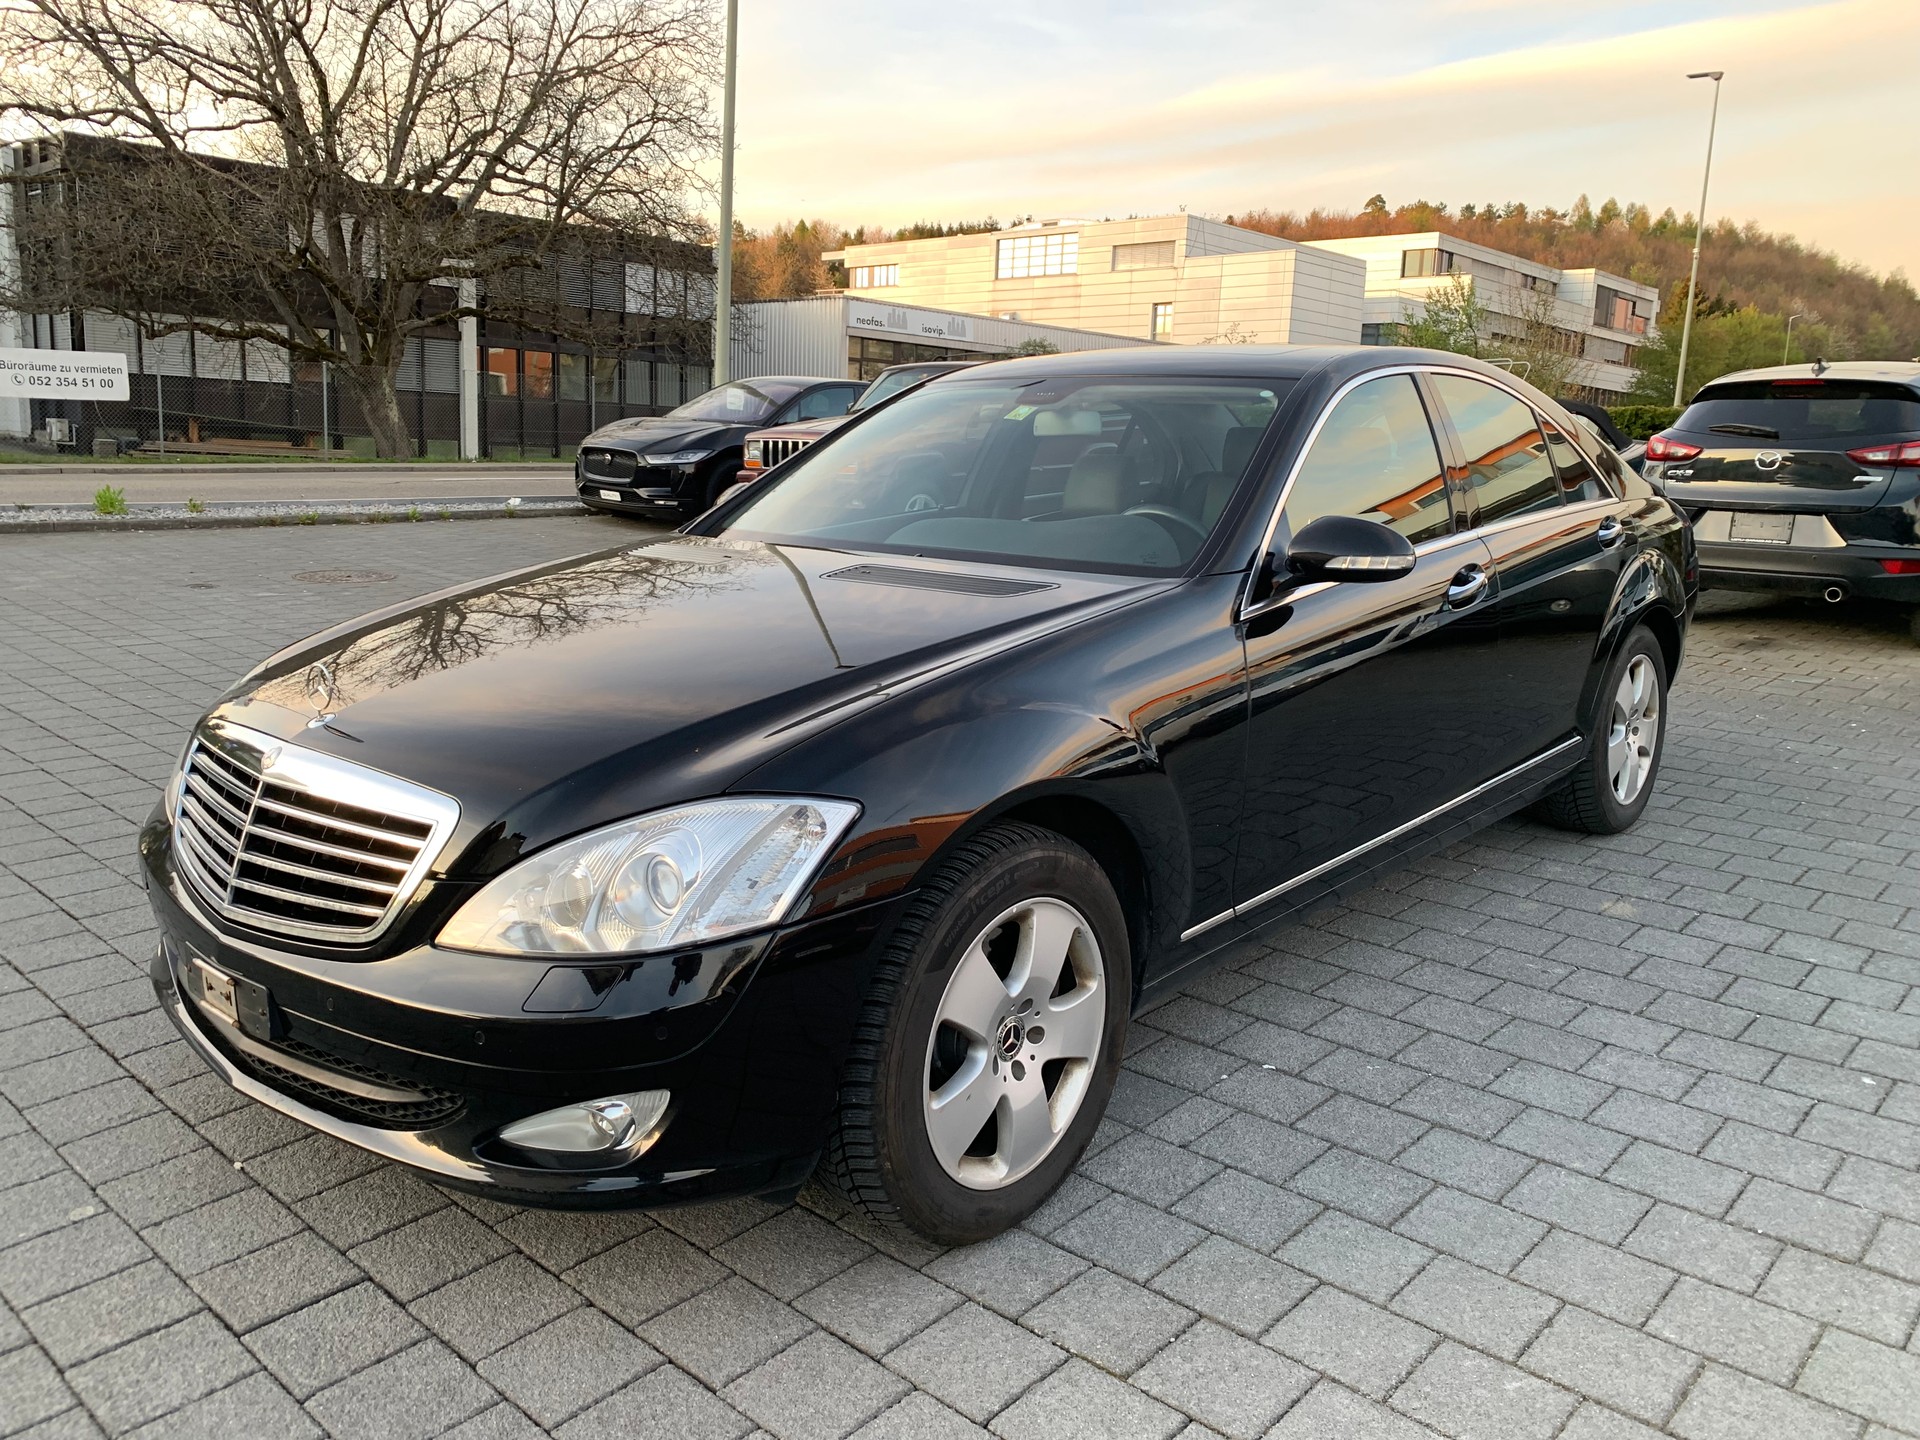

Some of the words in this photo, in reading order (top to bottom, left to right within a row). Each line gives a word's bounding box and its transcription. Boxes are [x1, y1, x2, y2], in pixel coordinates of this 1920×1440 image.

[0, 359, 57, 372] Büroräume
[59, 365, 71, 373] zu
[73, 364, 123, 375] vermieten
[28, 375, 52, 386] 052
[55, 376, 78, 387] 354
[81, 377, 95, 388] 51
[99, 378, 114, 388] 00
